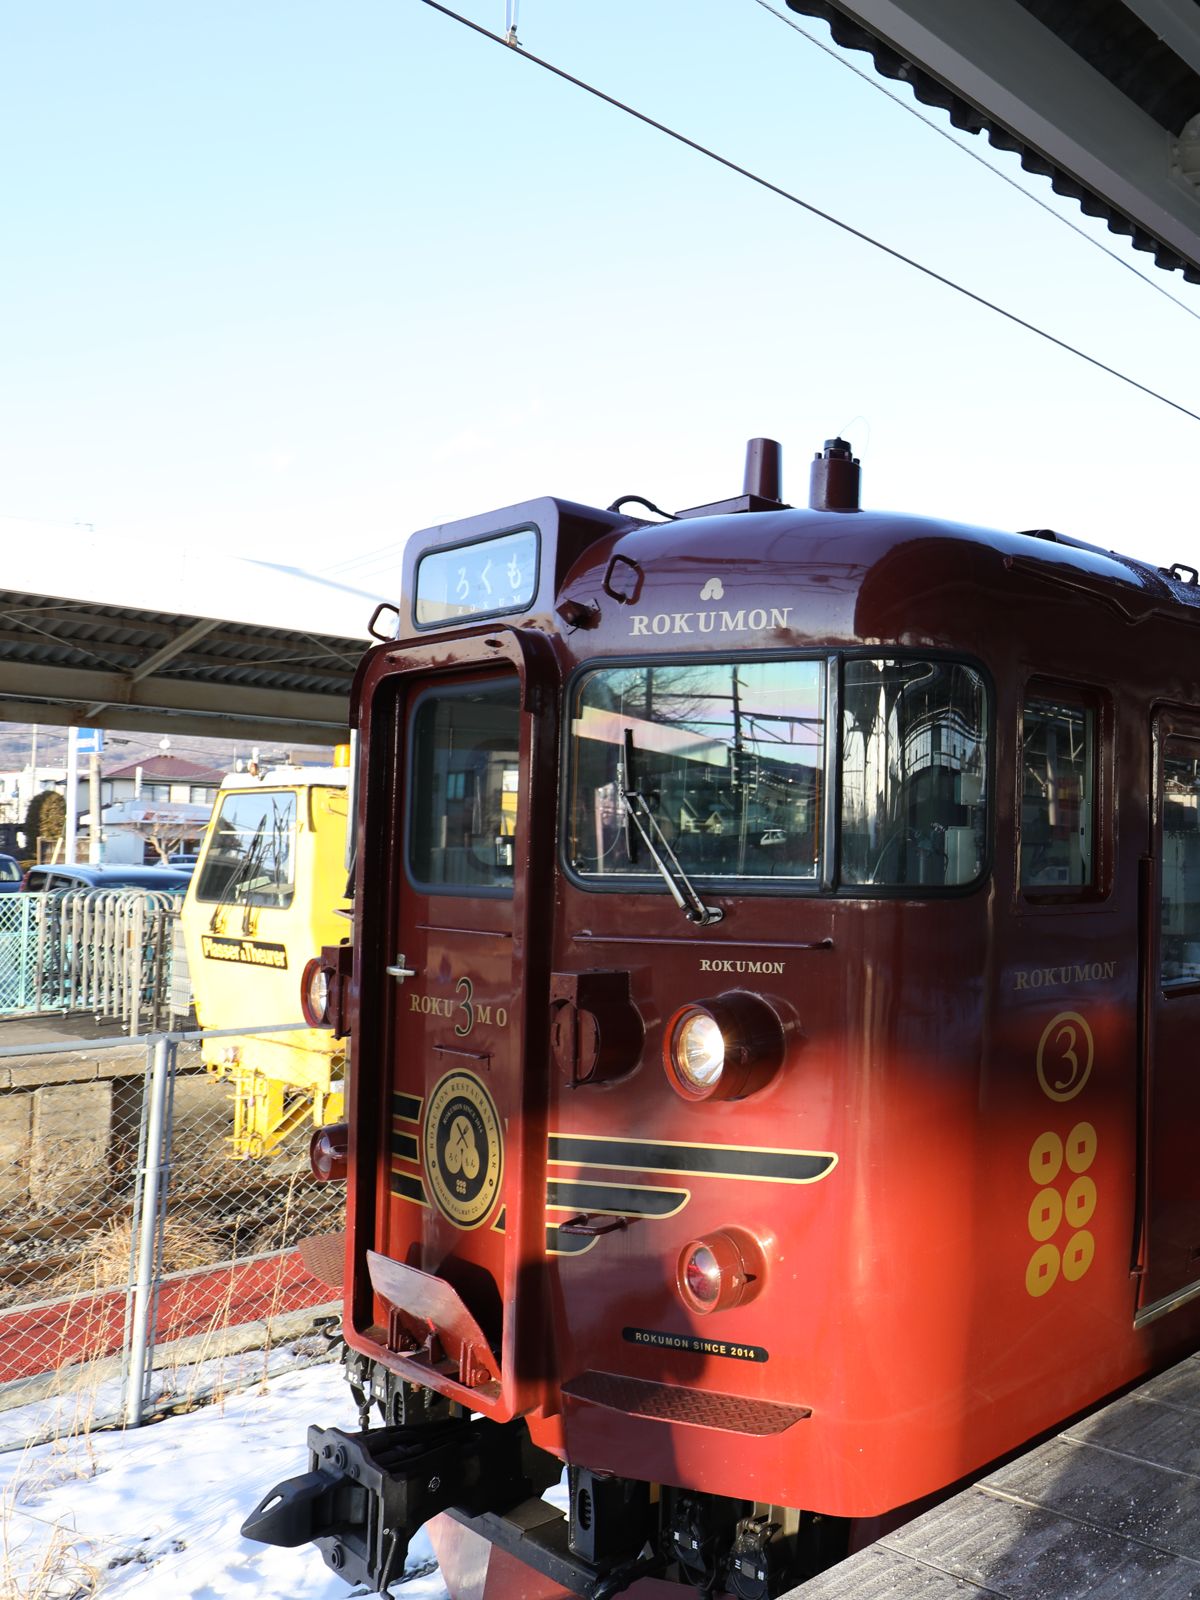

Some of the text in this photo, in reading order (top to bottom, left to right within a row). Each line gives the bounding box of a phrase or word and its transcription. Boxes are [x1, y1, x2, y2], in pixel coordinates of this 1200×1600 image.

[629, 607, 793, 636] ROKUMON
[699, 959, 786, 974] ROKUMON
[1013, 961, 1117, 991] ROKUMON
[409, 993, 454, 1018] ROKU
[454, 976, 474, 1037] 3
[451, 1083, 494, 1131] RESTAURANT
[635, 1332, 755, 1359] ROKUMON SINCE 2014
